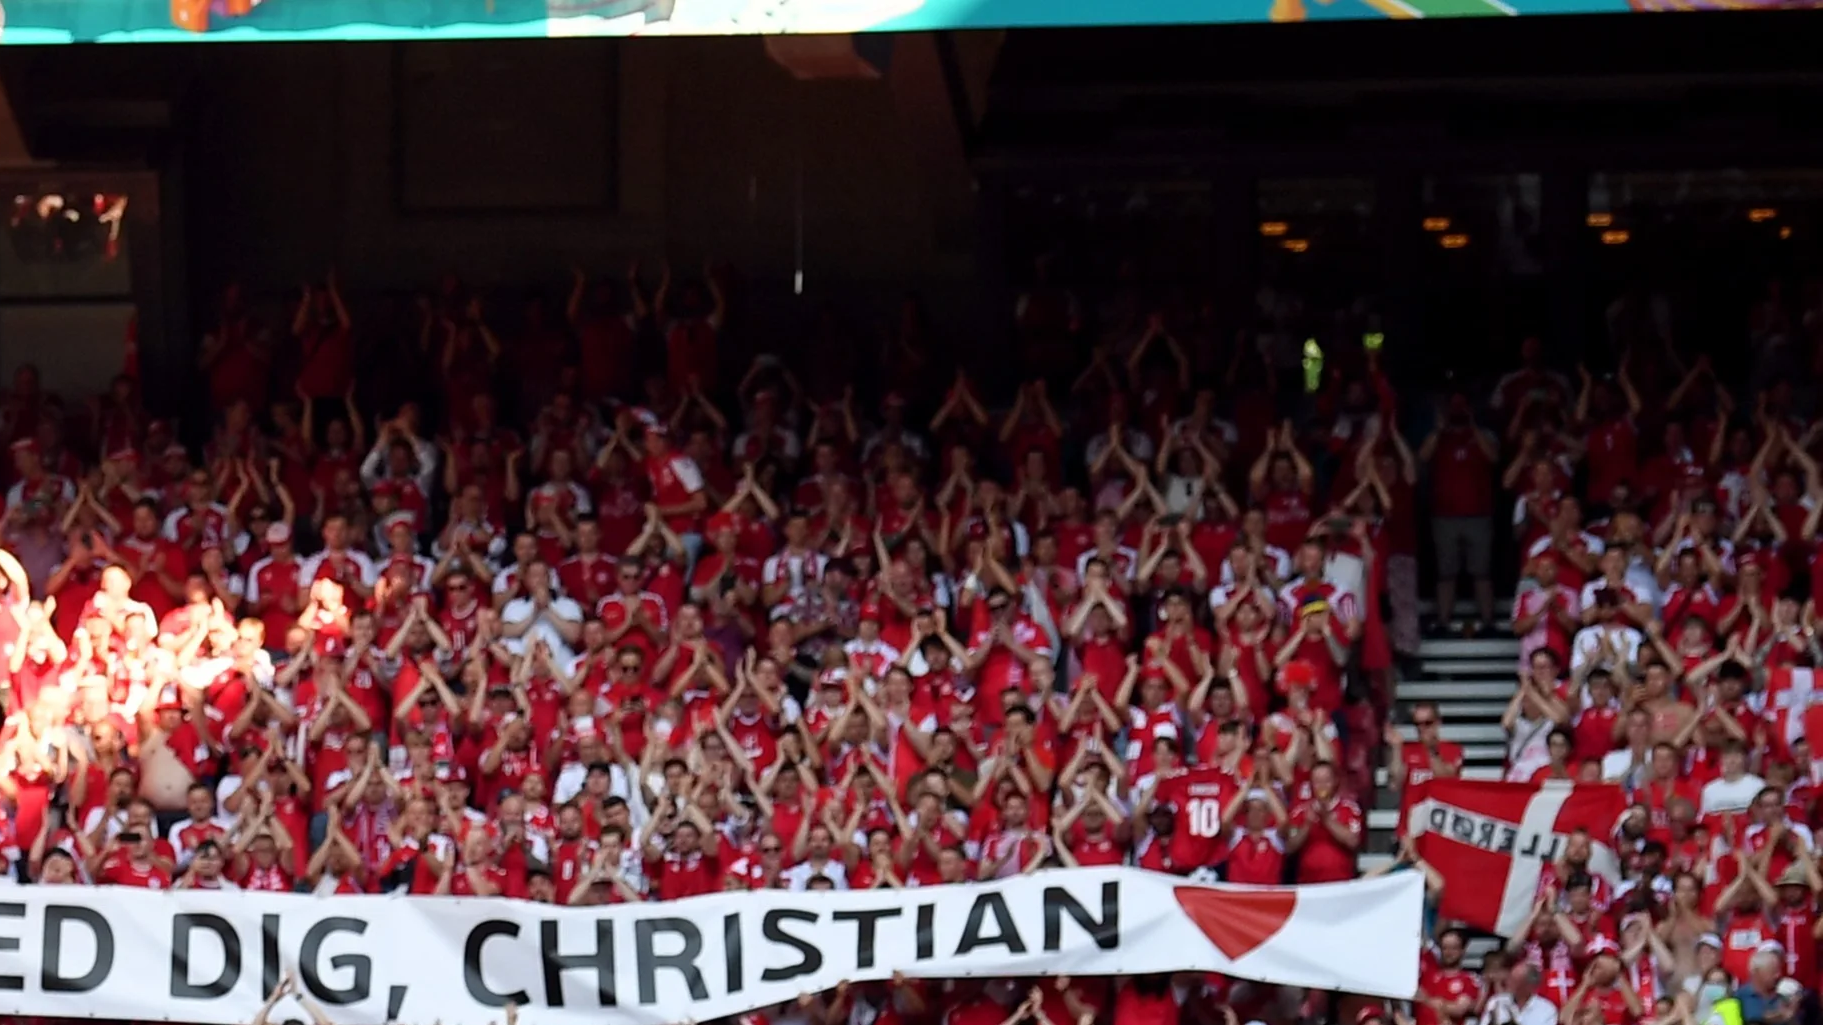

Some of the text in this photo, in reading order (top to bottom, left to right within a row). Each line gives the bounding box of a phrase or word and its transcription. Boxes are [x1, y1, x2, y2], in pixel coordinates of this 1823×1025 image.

[1185, 798, 1221, 838] 10
[169, 911, 409, 1021] DIG,
[462, 881, 1121, 1007] CHRISTIAN
